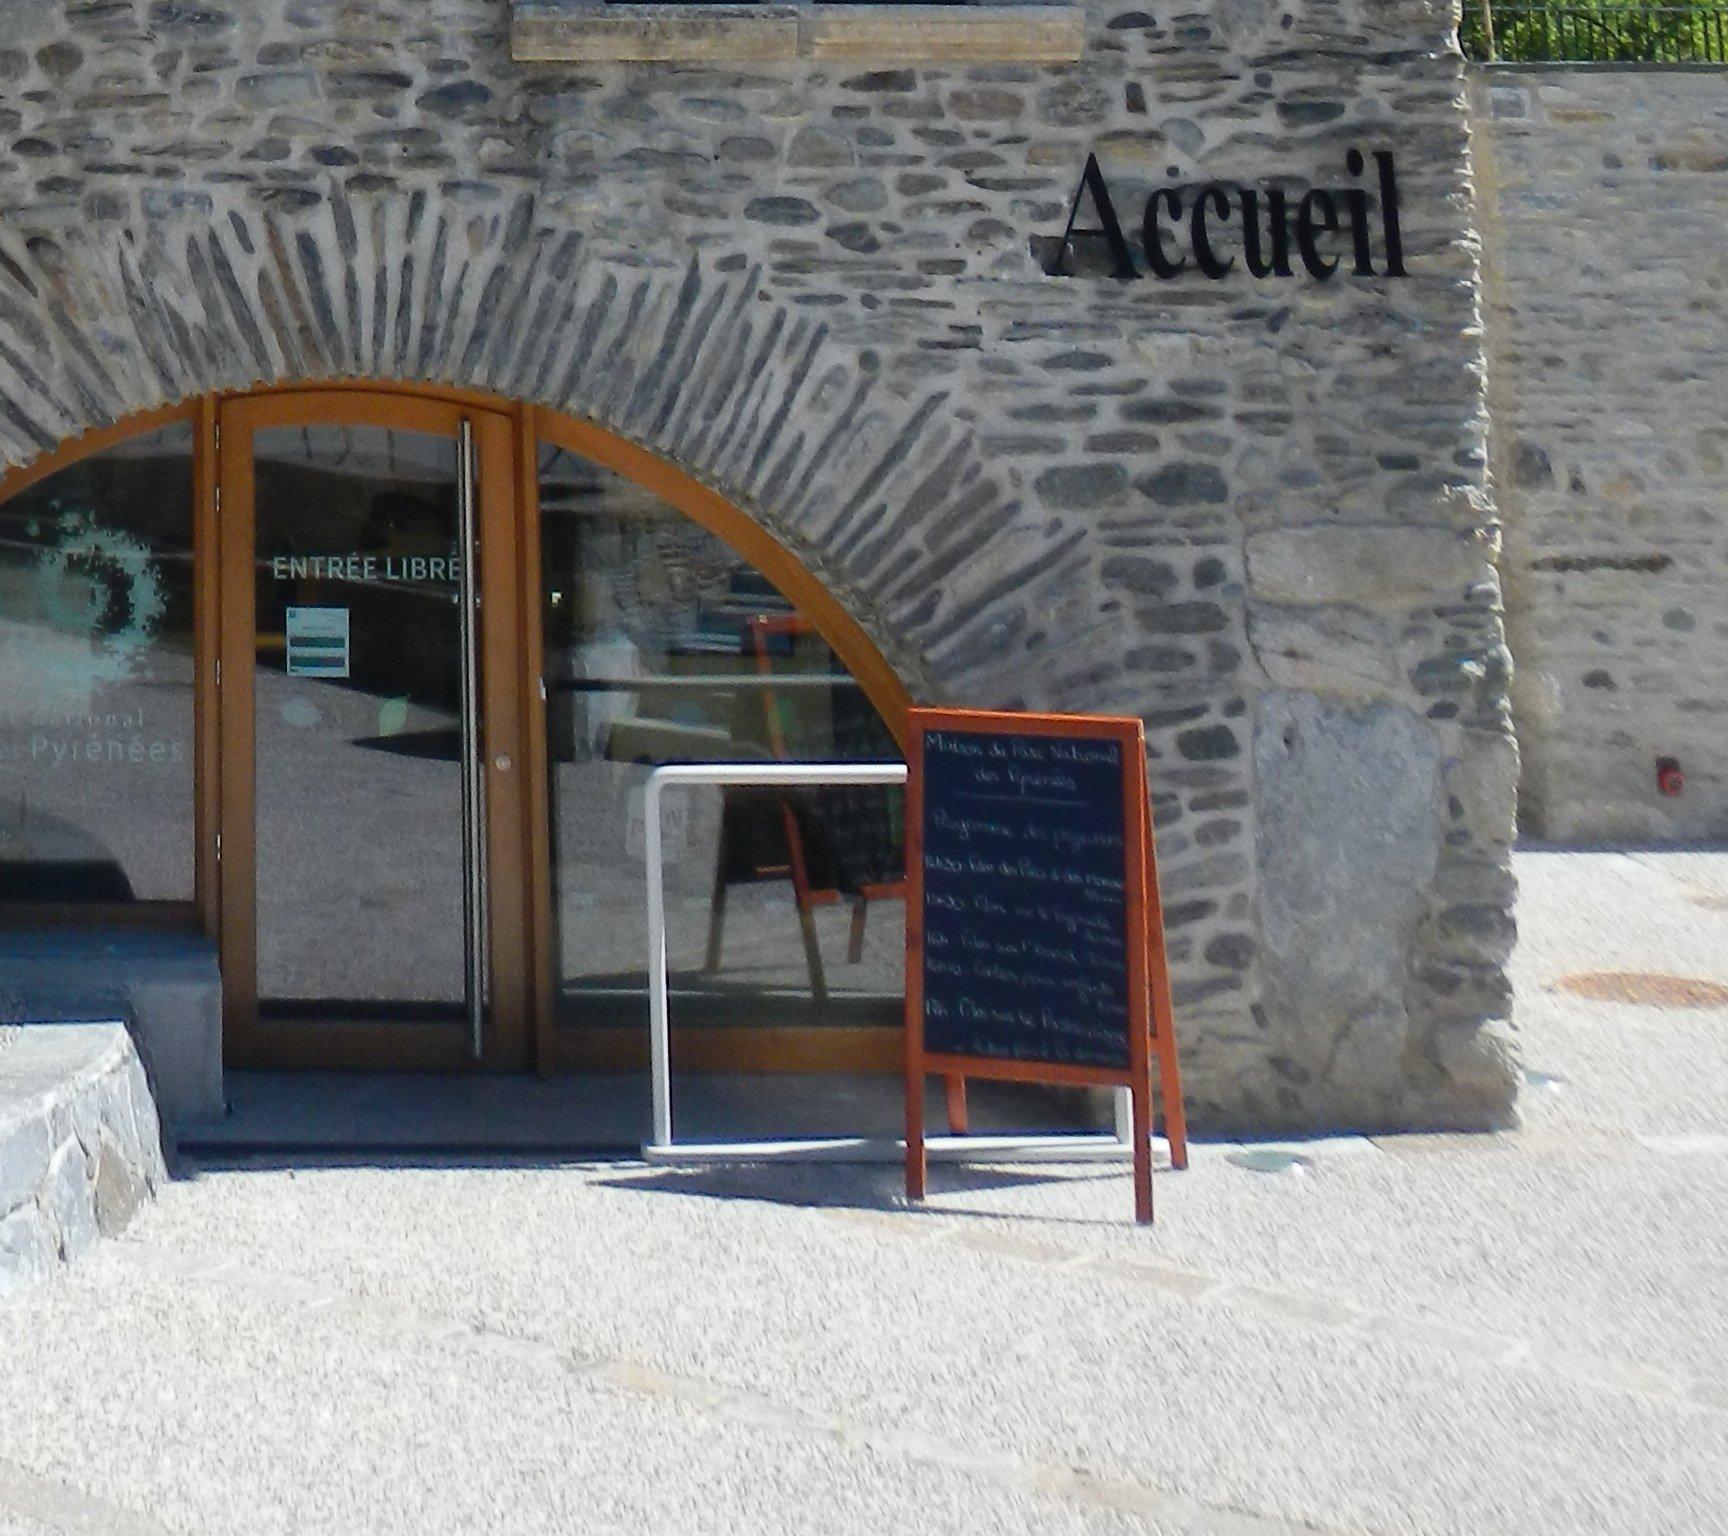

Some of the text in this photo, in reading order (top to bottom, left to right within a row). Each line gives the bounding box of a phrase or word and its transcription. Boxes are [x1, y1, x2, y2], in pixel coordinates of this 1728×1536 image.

[1045, 148, 1409, 280] Accueil
[273, 551, 377, 580] ENTRÉE
[29, 732, 184, 769] Pyrénées
